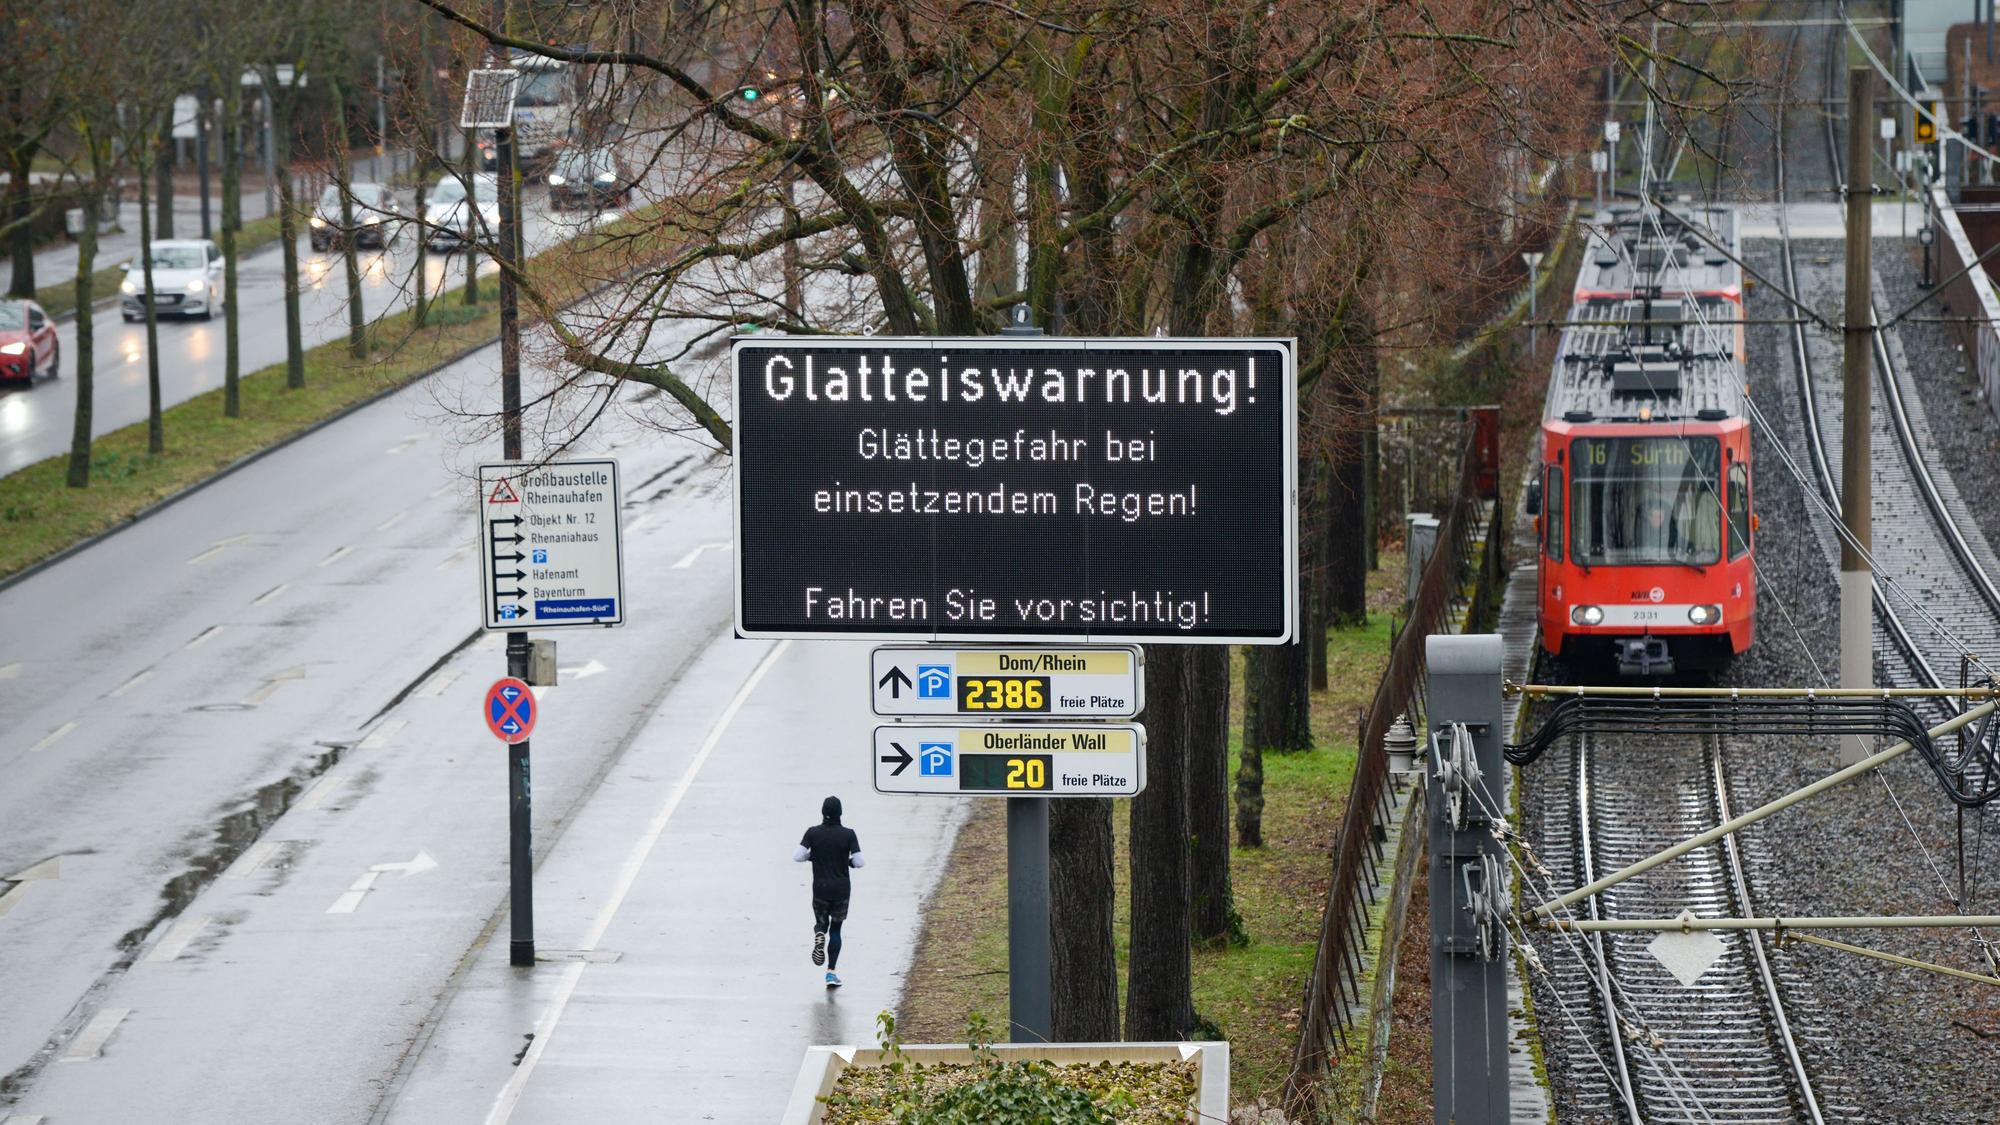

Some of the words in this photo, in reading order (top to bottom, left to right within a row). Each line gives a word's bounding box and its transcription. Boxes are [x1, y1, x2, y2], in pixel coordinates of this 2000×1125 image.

[765, 354, 1255, 416] Glatteiswarnung!
[858, 428, 1087, 467] Glättegefahr
[1106, 429, 1155, 462] bei
[1588, 444, 1606, 465] 16
[521, 471, 608, 488] Großbaustelle
[527, 490, 603, 504] Rheinauhafen
[814, 481, 1057, 515] einsetzendem
[1076, 483, 1196, 522] Regen!
[530, 514, 561, 528] Objekt
[566, 513, 580, 524] Nr.
[585, 512, 595, 524] 12
[531, 532, 599, 544] Rhenaniahaus
[532, 569, 578, 580] Hafenamt
[533, 586, 586, 600] Bayenturm
[806, 587, 927, 620] Fahren
[946, 588, 996, 621] Sie
[1015, 590, 1208, 629] vorsichtig!
[1633, 611, 1658, 620] 2331
[999, 654, 1086, 673] Dom/Rhein
[966, 679, 1043, 709] 2386
[1060, 695, 1086, 708] freie
[1090, 694, 1125, 708] Plätze
[984, 733, 1067, 750] Oberländer
[1072, 734, 1106, 750] Wall
[1007, 759, 1045, 788] 20
[1062, 774, 1088, 786] freie
[1092, 773, 1127, 787] Plätze
